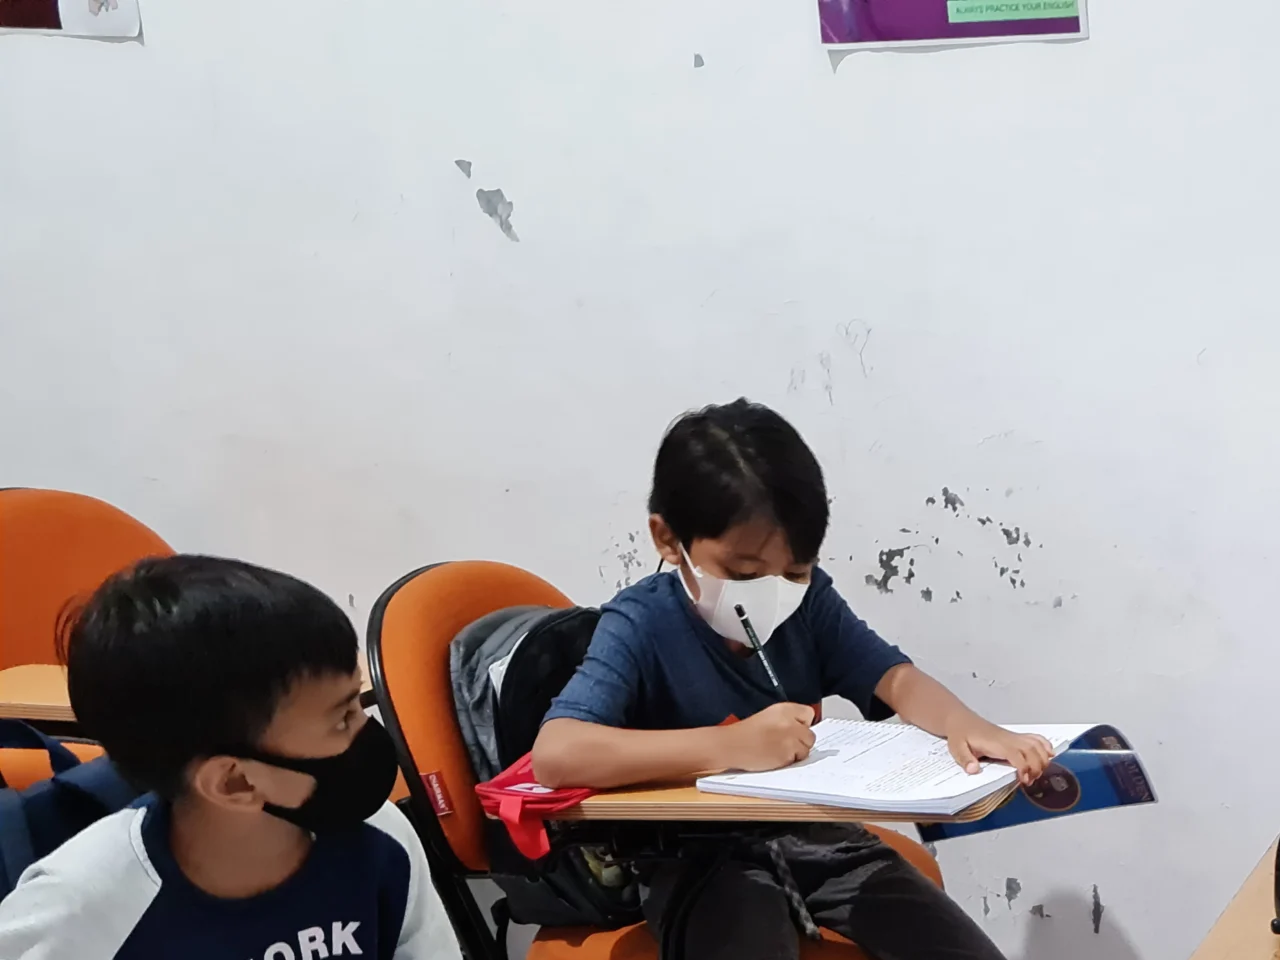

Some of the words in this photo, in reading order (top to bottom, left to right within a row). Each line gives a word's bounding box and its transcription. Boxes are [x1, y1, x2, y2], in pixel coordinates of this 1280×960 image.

[985, 3, 1020, 13] PRACTICE
[1022, 2, 1041, 11] YOUR
[1043, 0, 1075, 10] ENGLISH
